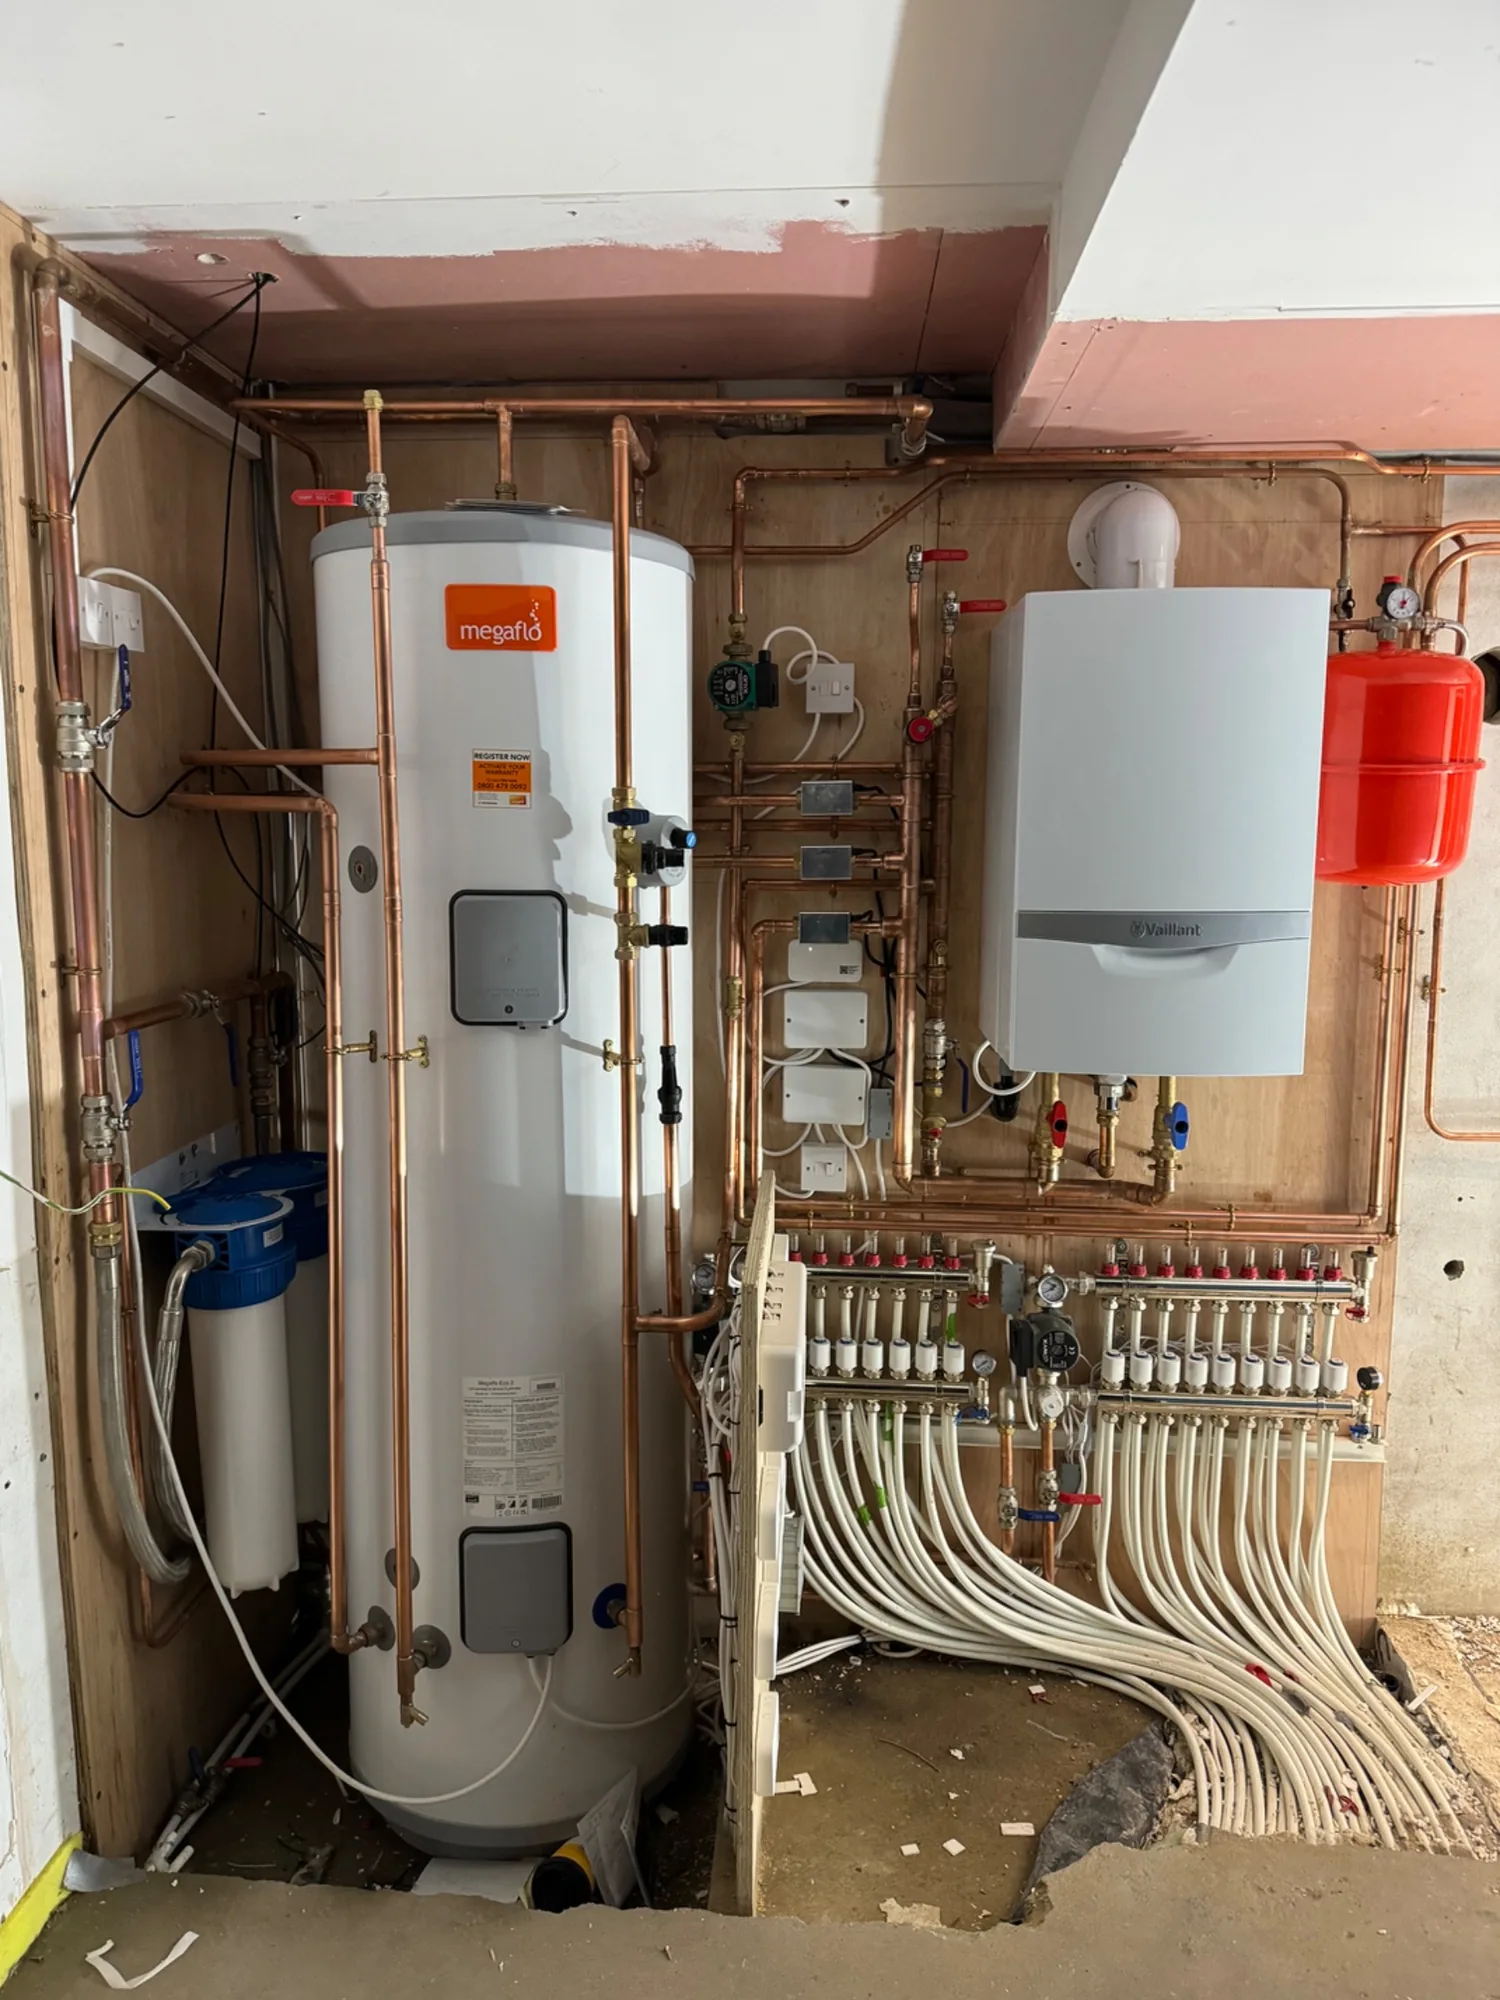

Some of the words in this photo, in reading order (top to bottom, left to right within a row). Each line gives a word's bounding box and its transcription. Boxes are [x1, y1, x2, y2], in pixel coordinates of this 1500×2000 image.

[460, 620, 542, 645] megaflo
[473, 752, 509, 760] REGISTER
[1146, 921, 1203, 936] Vaillant
